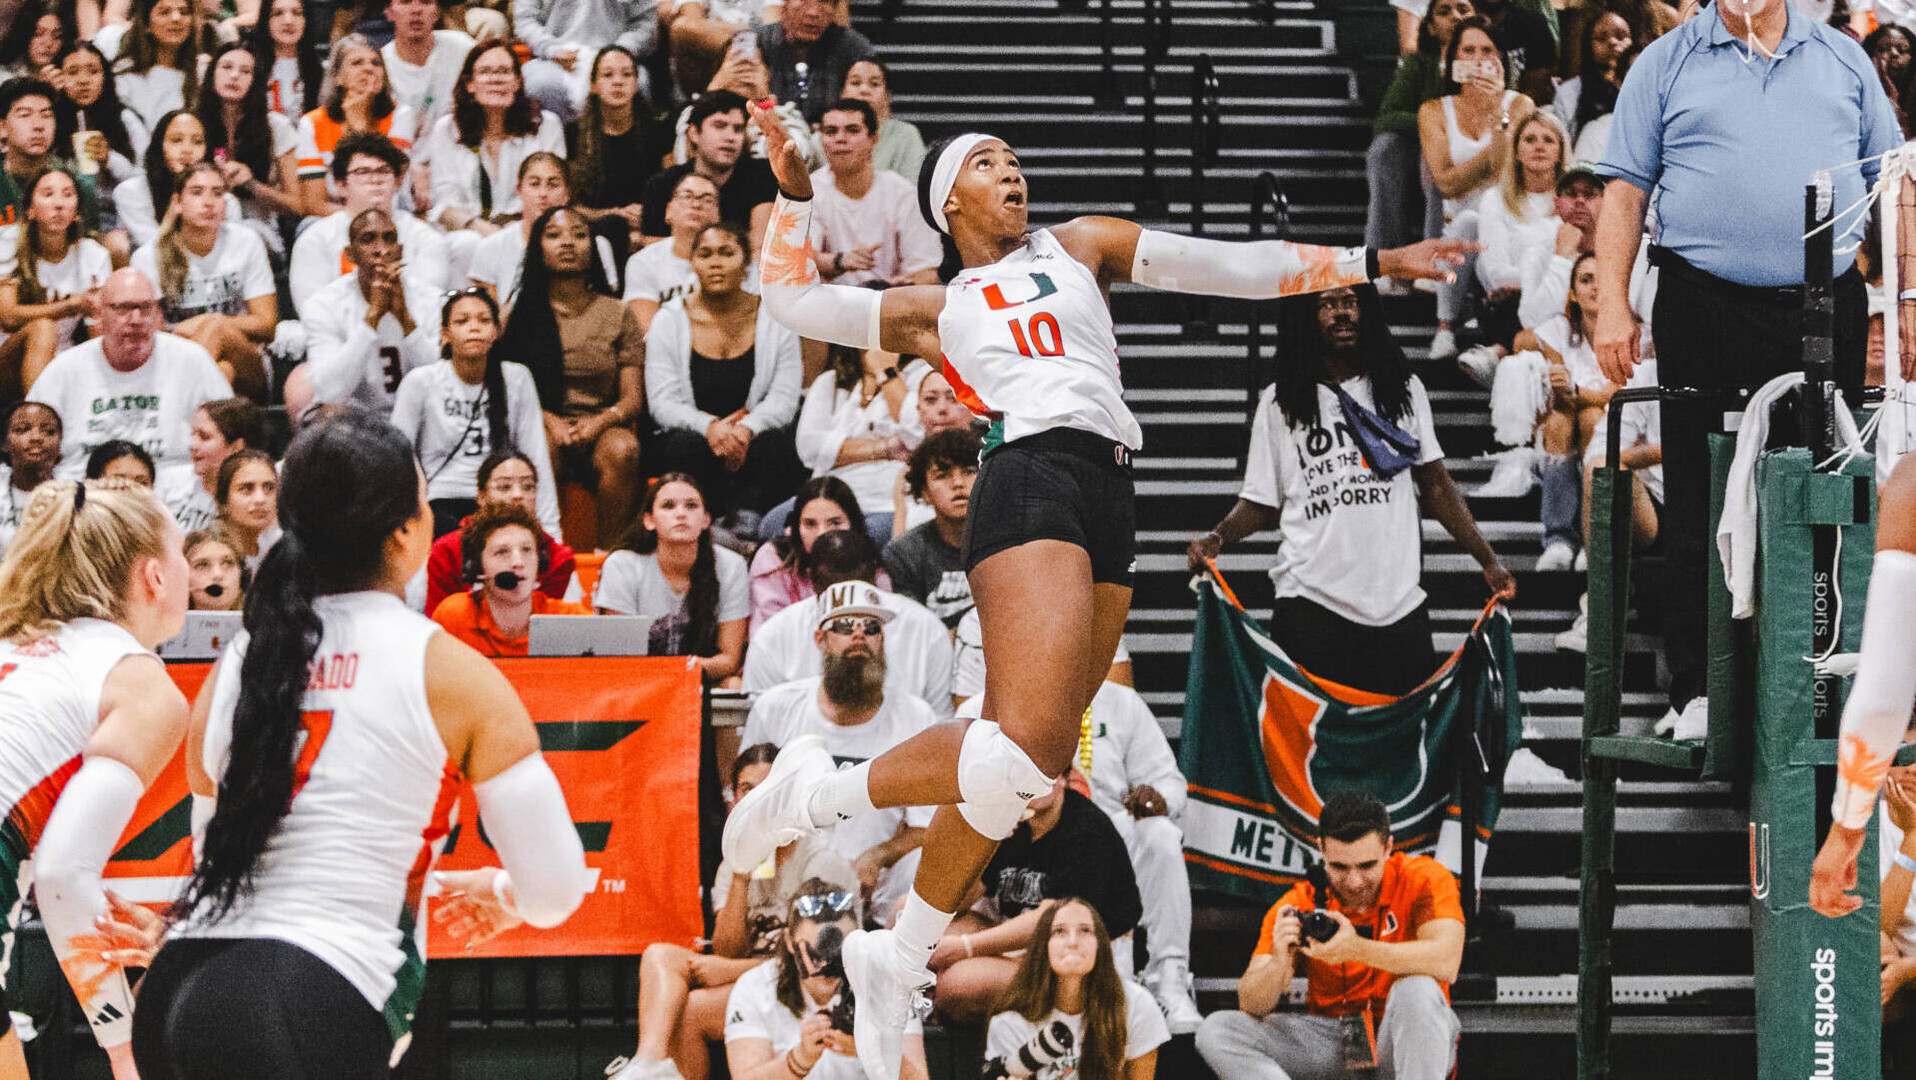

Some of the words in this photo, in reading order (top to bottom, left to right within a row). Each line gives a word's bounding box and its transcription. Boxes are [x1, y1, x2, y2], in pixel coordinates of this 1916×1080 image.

[1008, 311, 1066, 358] 10
[379, 345, 403, 394] 3
[1813, 572, 1829, 637] sports
[306, 652, 359, 691] ADO
[603, 879, 626, 893] TM
[1810, 947, 1839, 1037] sports
